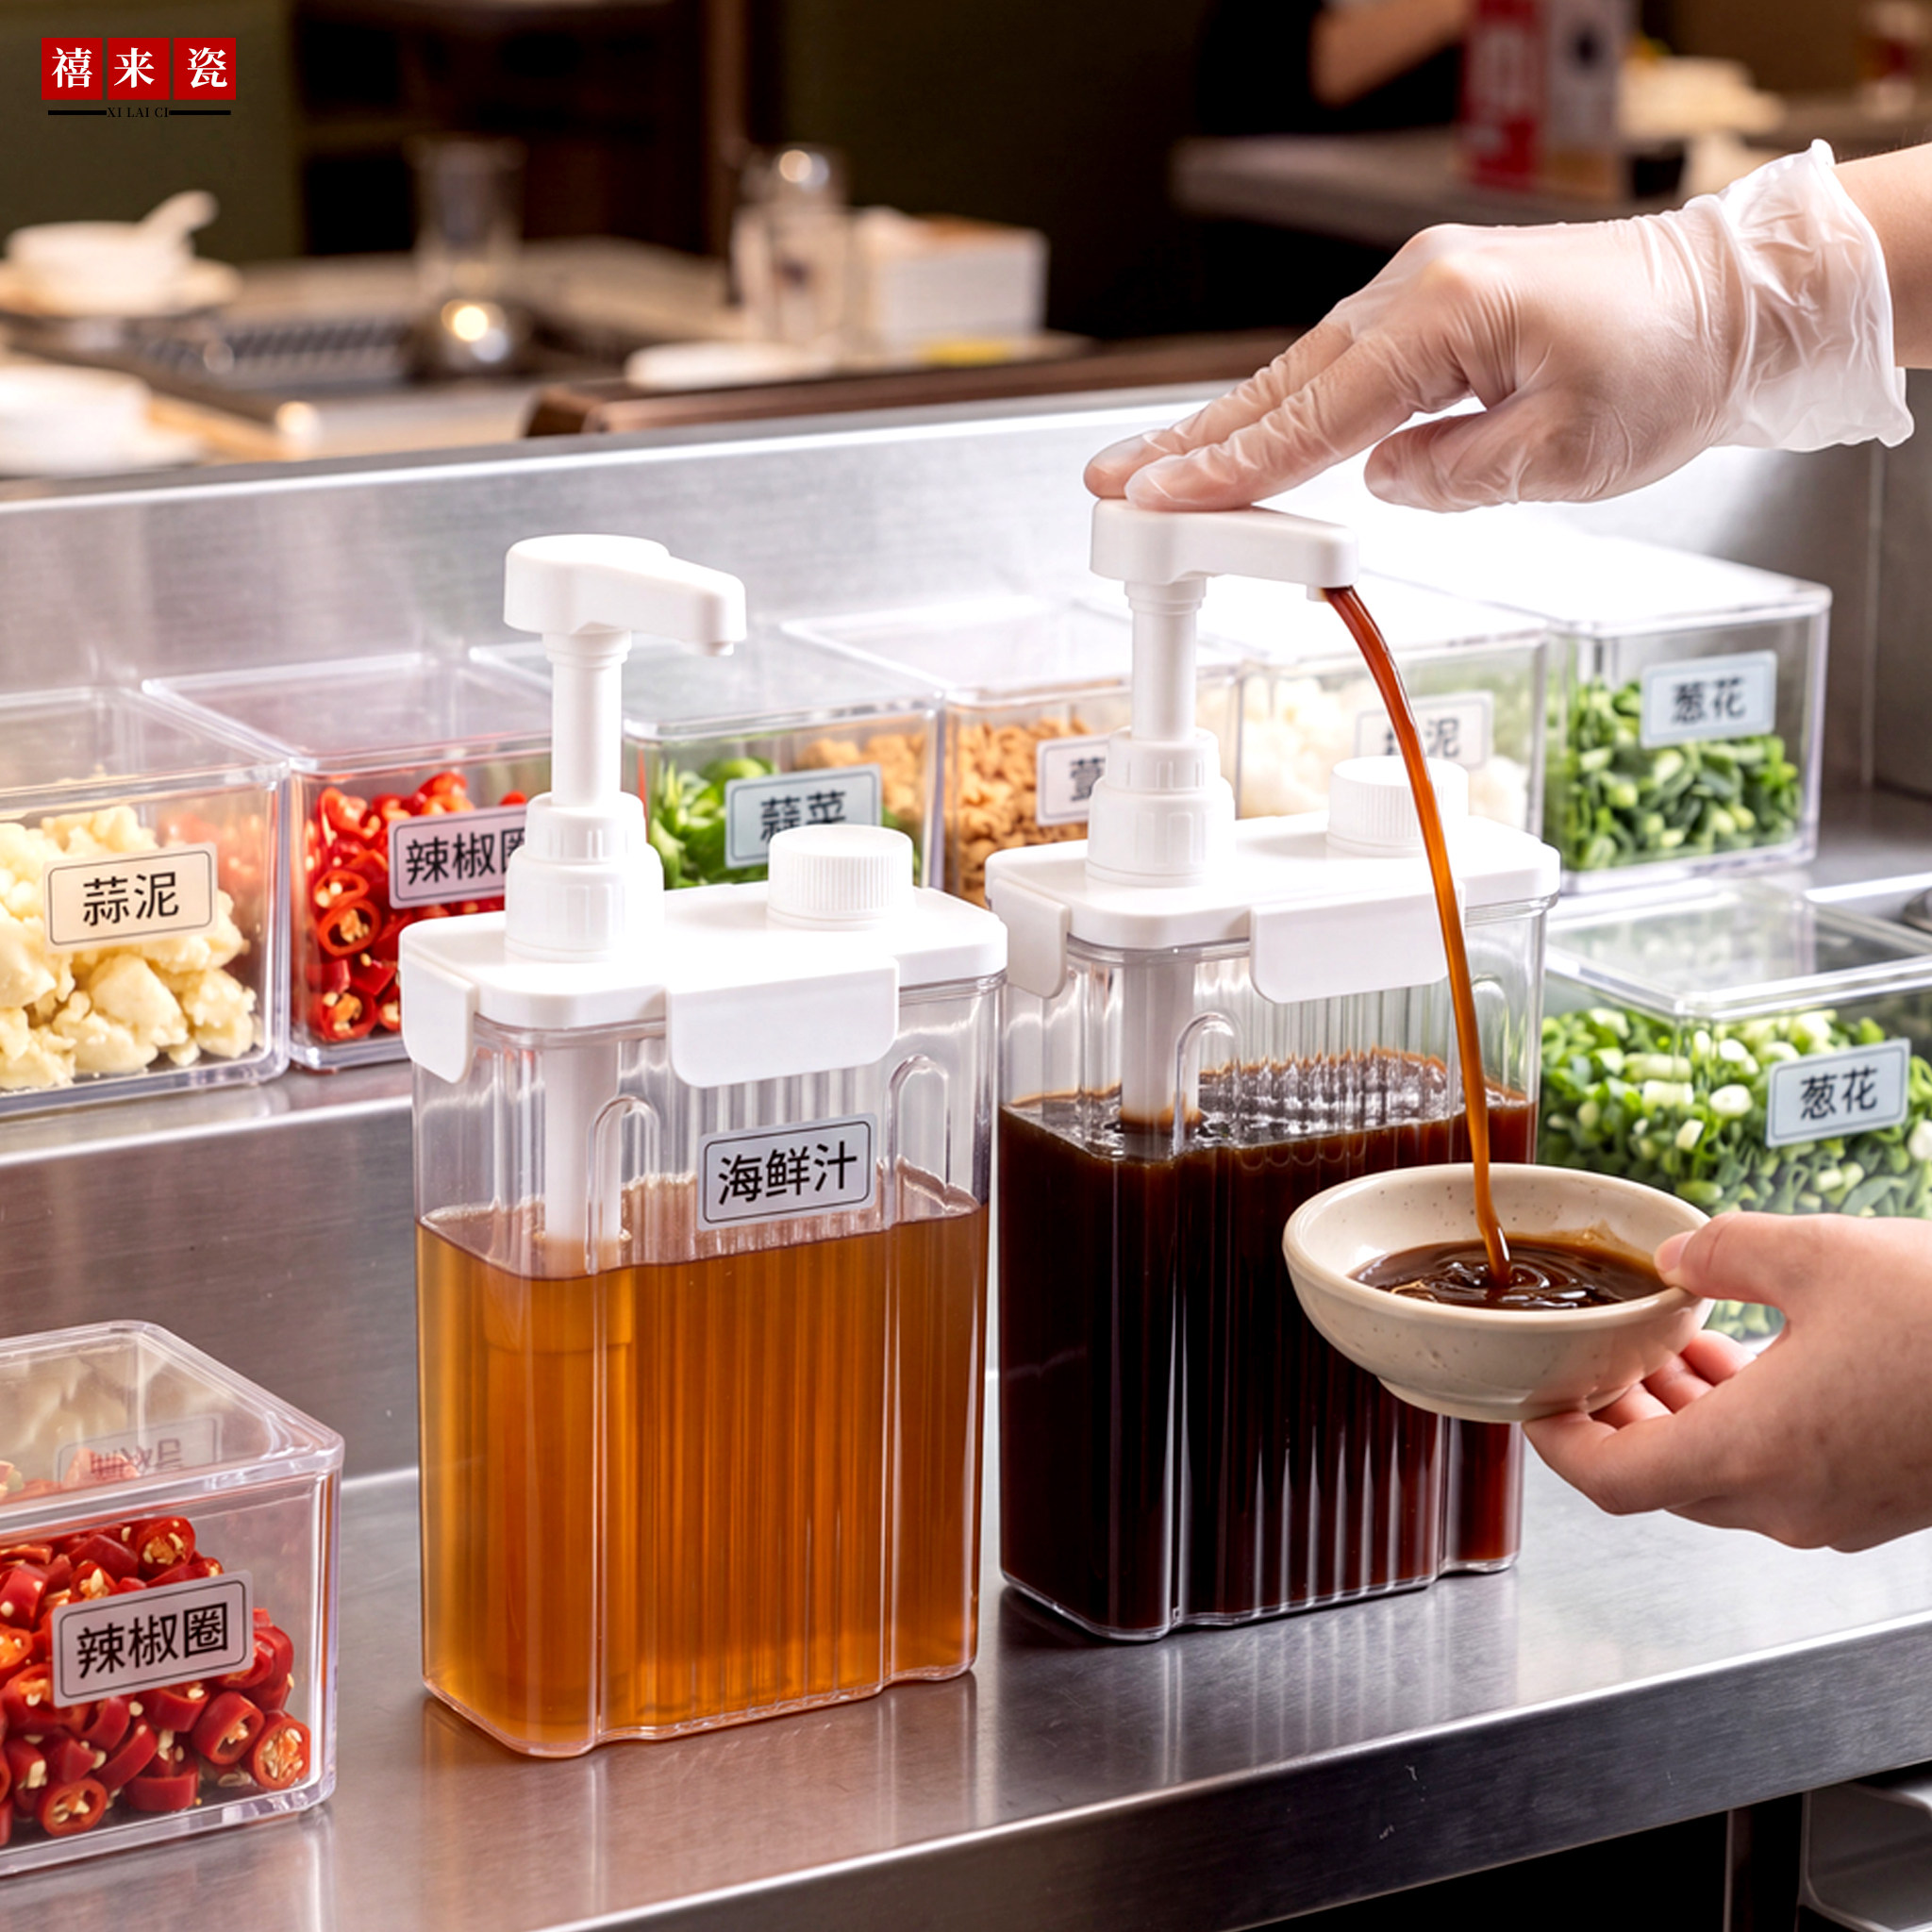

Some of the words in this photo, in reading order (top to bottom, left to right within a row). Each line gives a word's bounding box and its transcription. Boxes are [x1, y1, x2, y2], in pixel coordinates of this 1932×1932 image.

[83, 871, 179, 926] 蒜泥
[1800, 1065, 1877, 1121] 葱花
[718, 1141, 857, 1205] 海鲜汁
[77, 1602, 228, 1679] 辣椒圈
